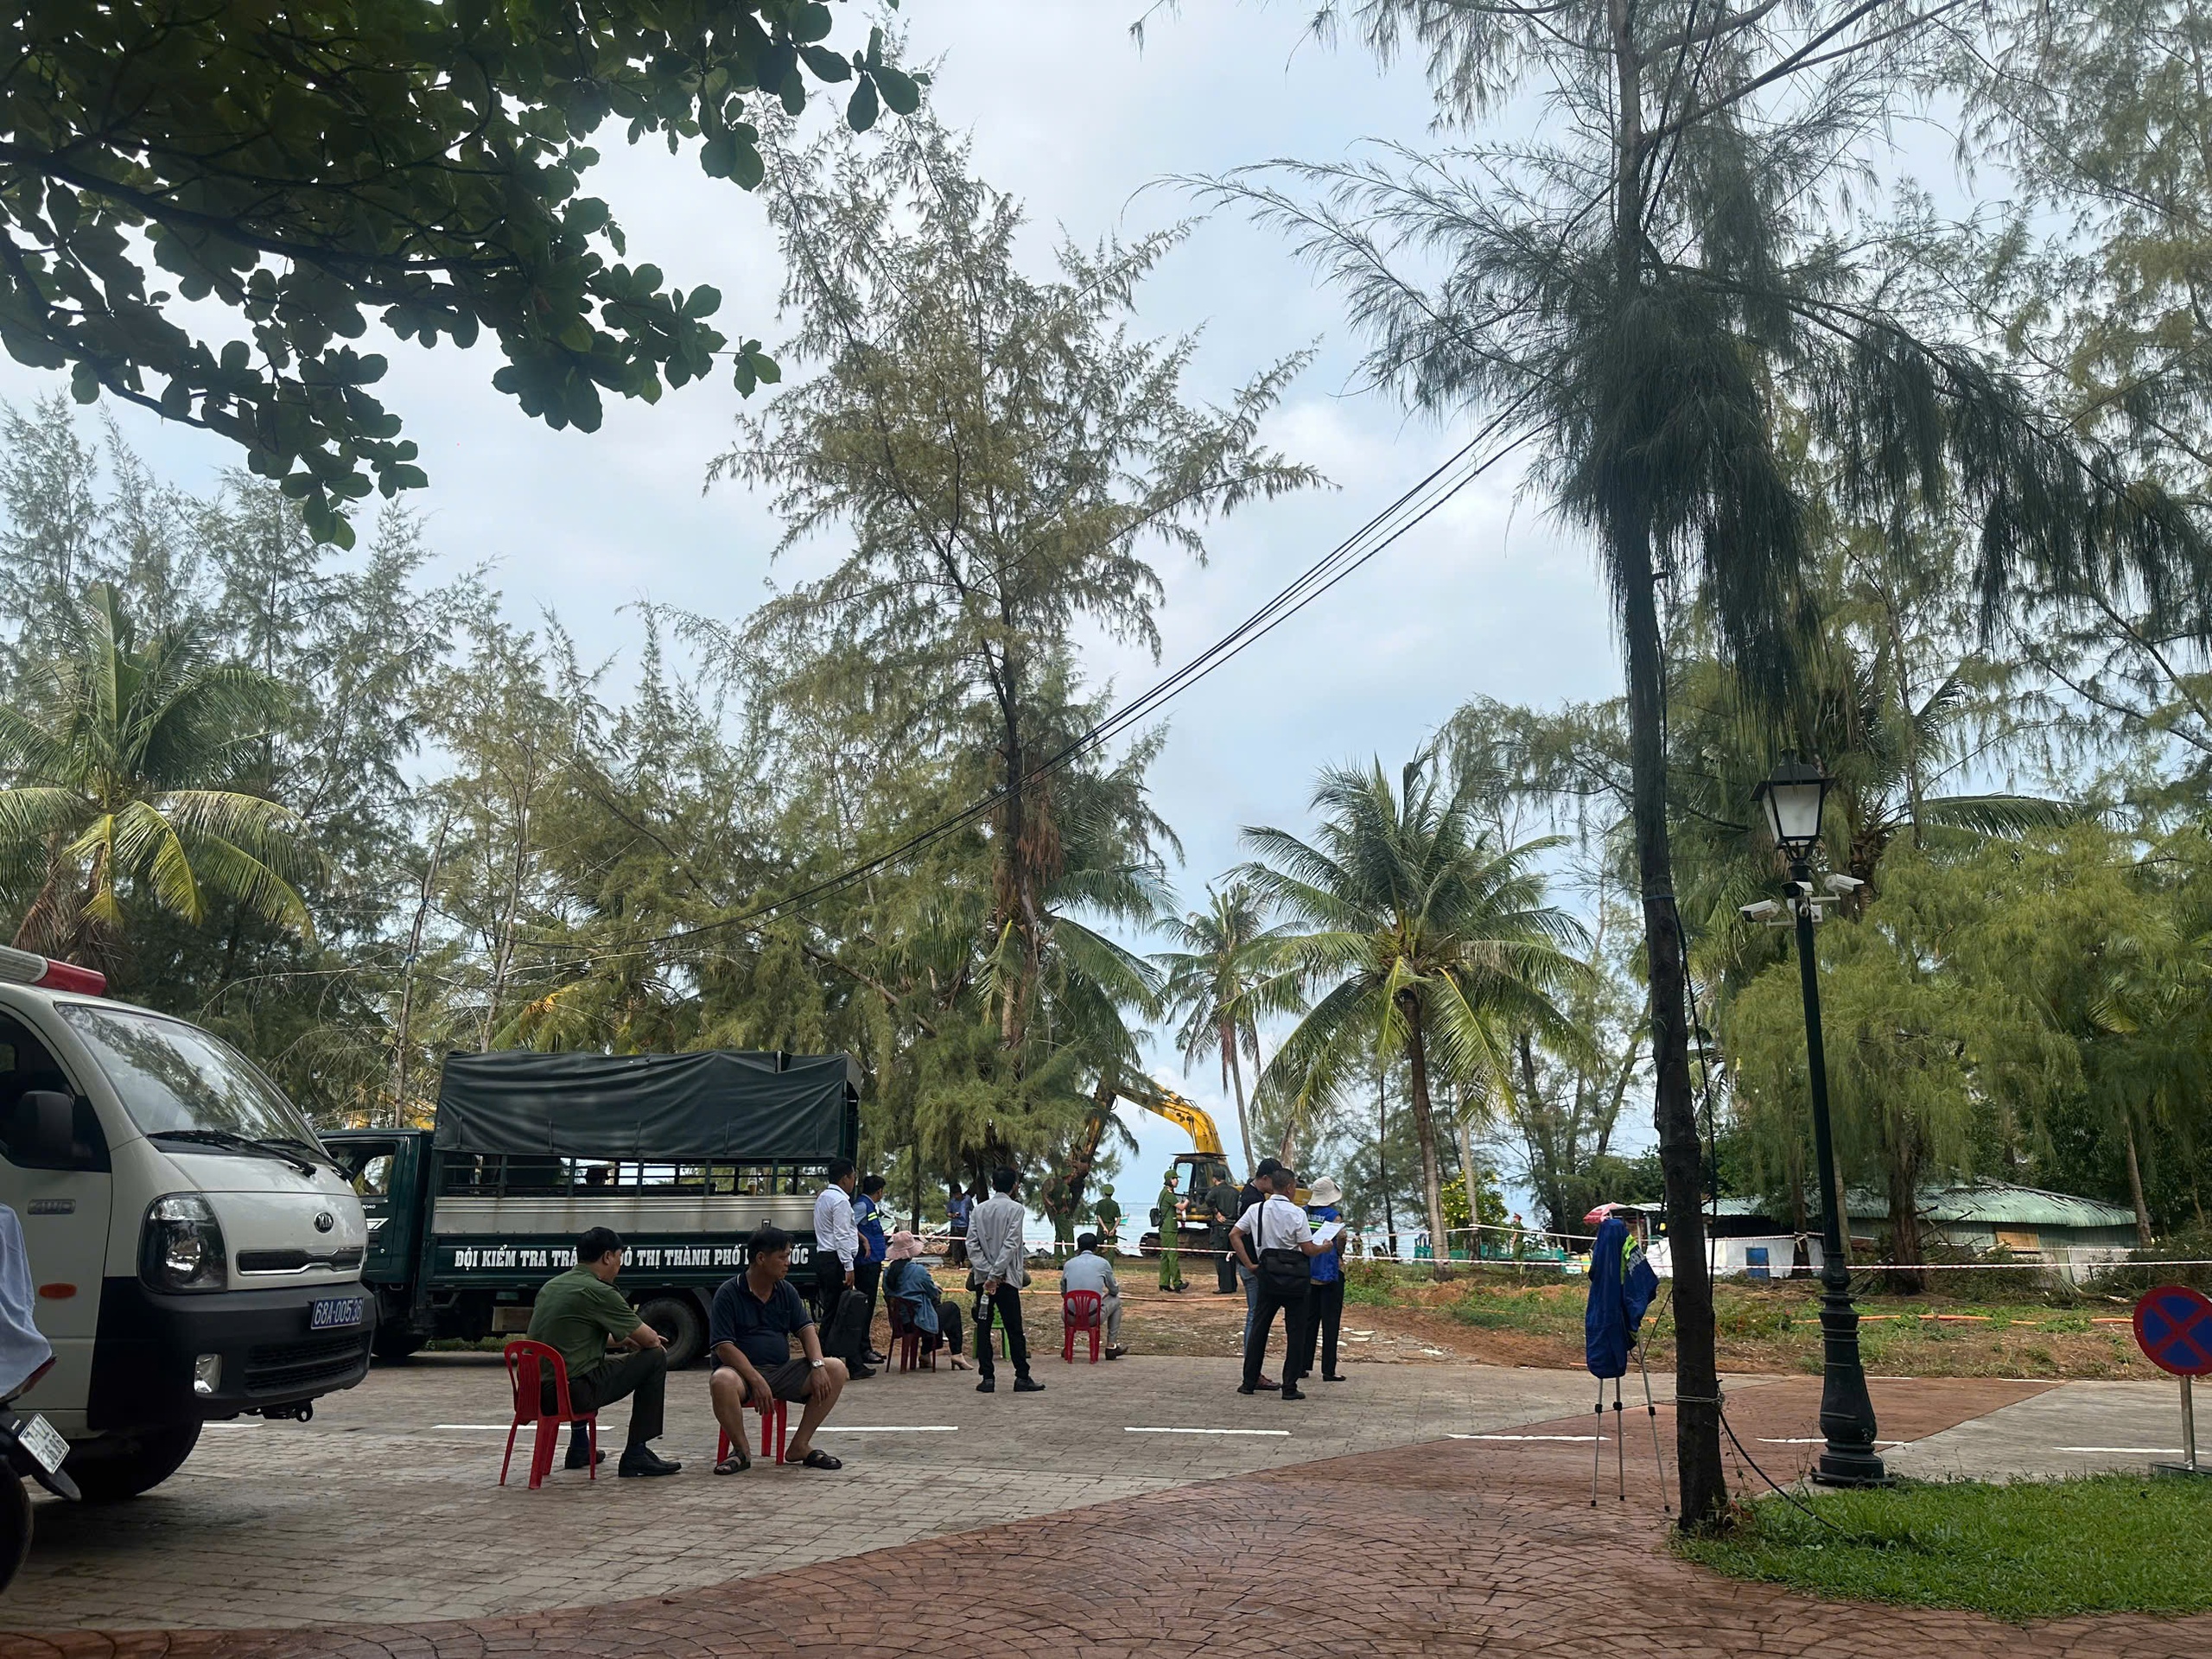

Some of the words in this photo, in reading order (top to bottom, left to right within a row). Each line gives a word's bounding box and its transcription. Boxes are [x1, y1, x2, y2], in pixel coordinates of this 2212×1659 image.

[454, 1246, 478, 1271] ĐỘI
[481, 1244, 517, 1268] KIỂM
[520, 1250, 548, 1268] TRA
[637, 1249, 661, 1269] THỊ
[664, 1245, 710, 1266] THÀNH
[714, 1243, 741, 1265] PHỐ
